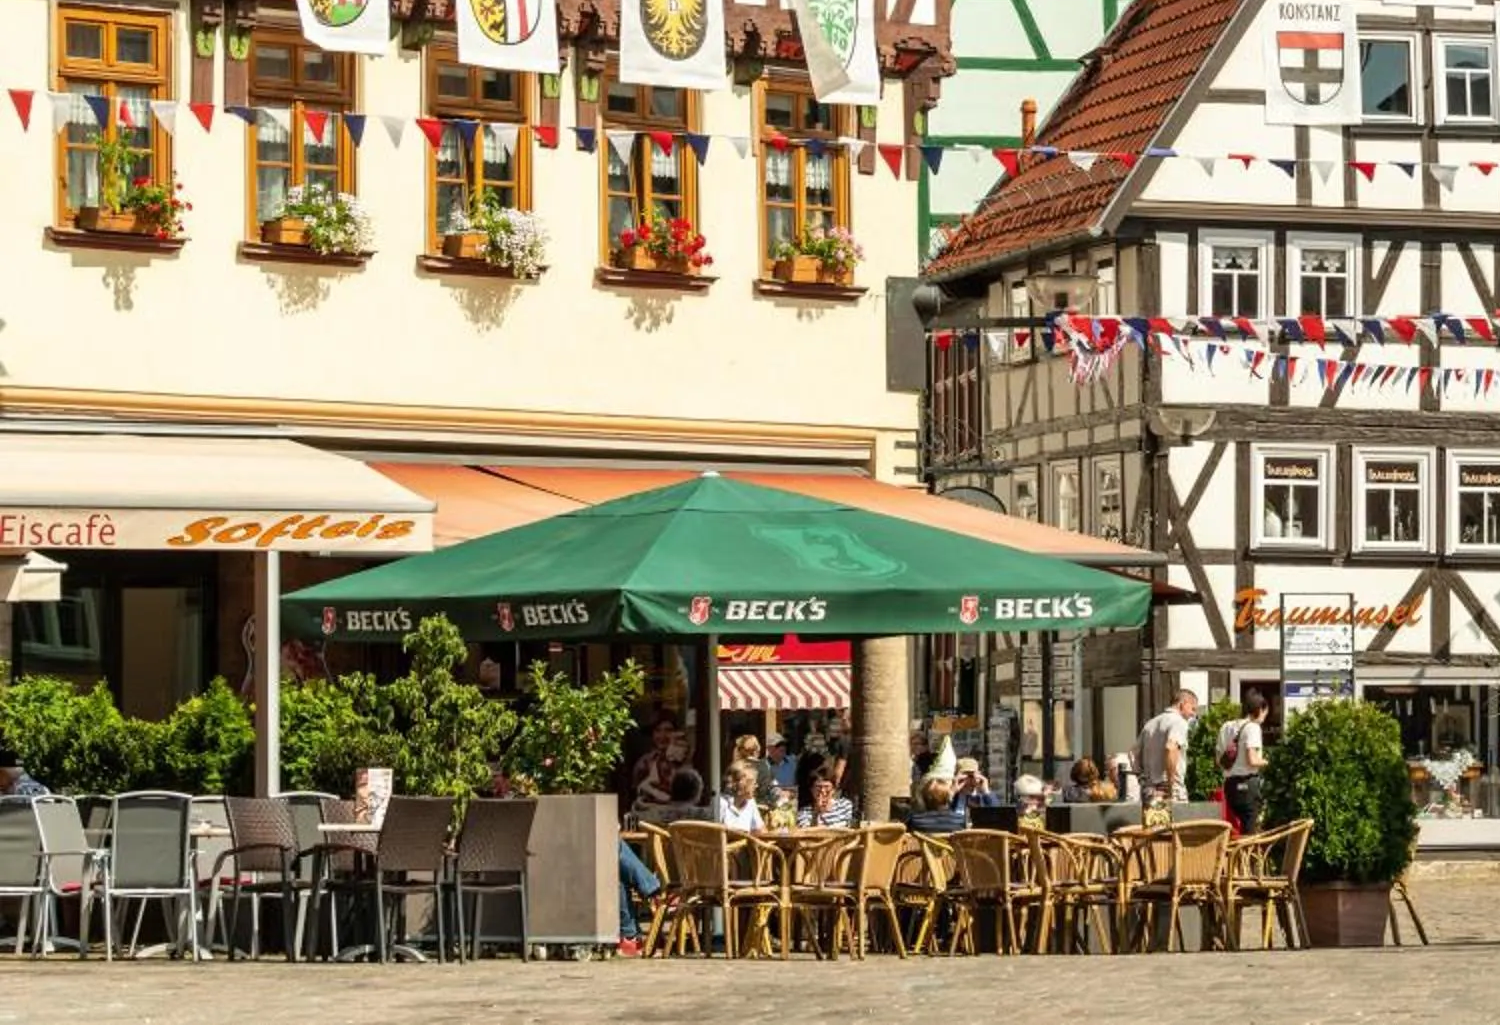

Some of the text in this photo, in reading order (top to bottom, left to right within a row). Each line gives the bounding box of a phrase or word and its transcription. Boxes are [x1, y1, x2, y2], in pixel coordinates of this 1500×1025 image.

[1278, 3, 1342, 22] KONSTANZ
[167, 514, 415, 548] Softeis
[346, 607, 412, 631] BECK'S
[522, 599, 589, 626] BECK'S
[725, 596, 827, 620] BECK'S
[995, 592, 1093, 619] BECK'S
[1234, 587, 1425, 632] Trauminsel
